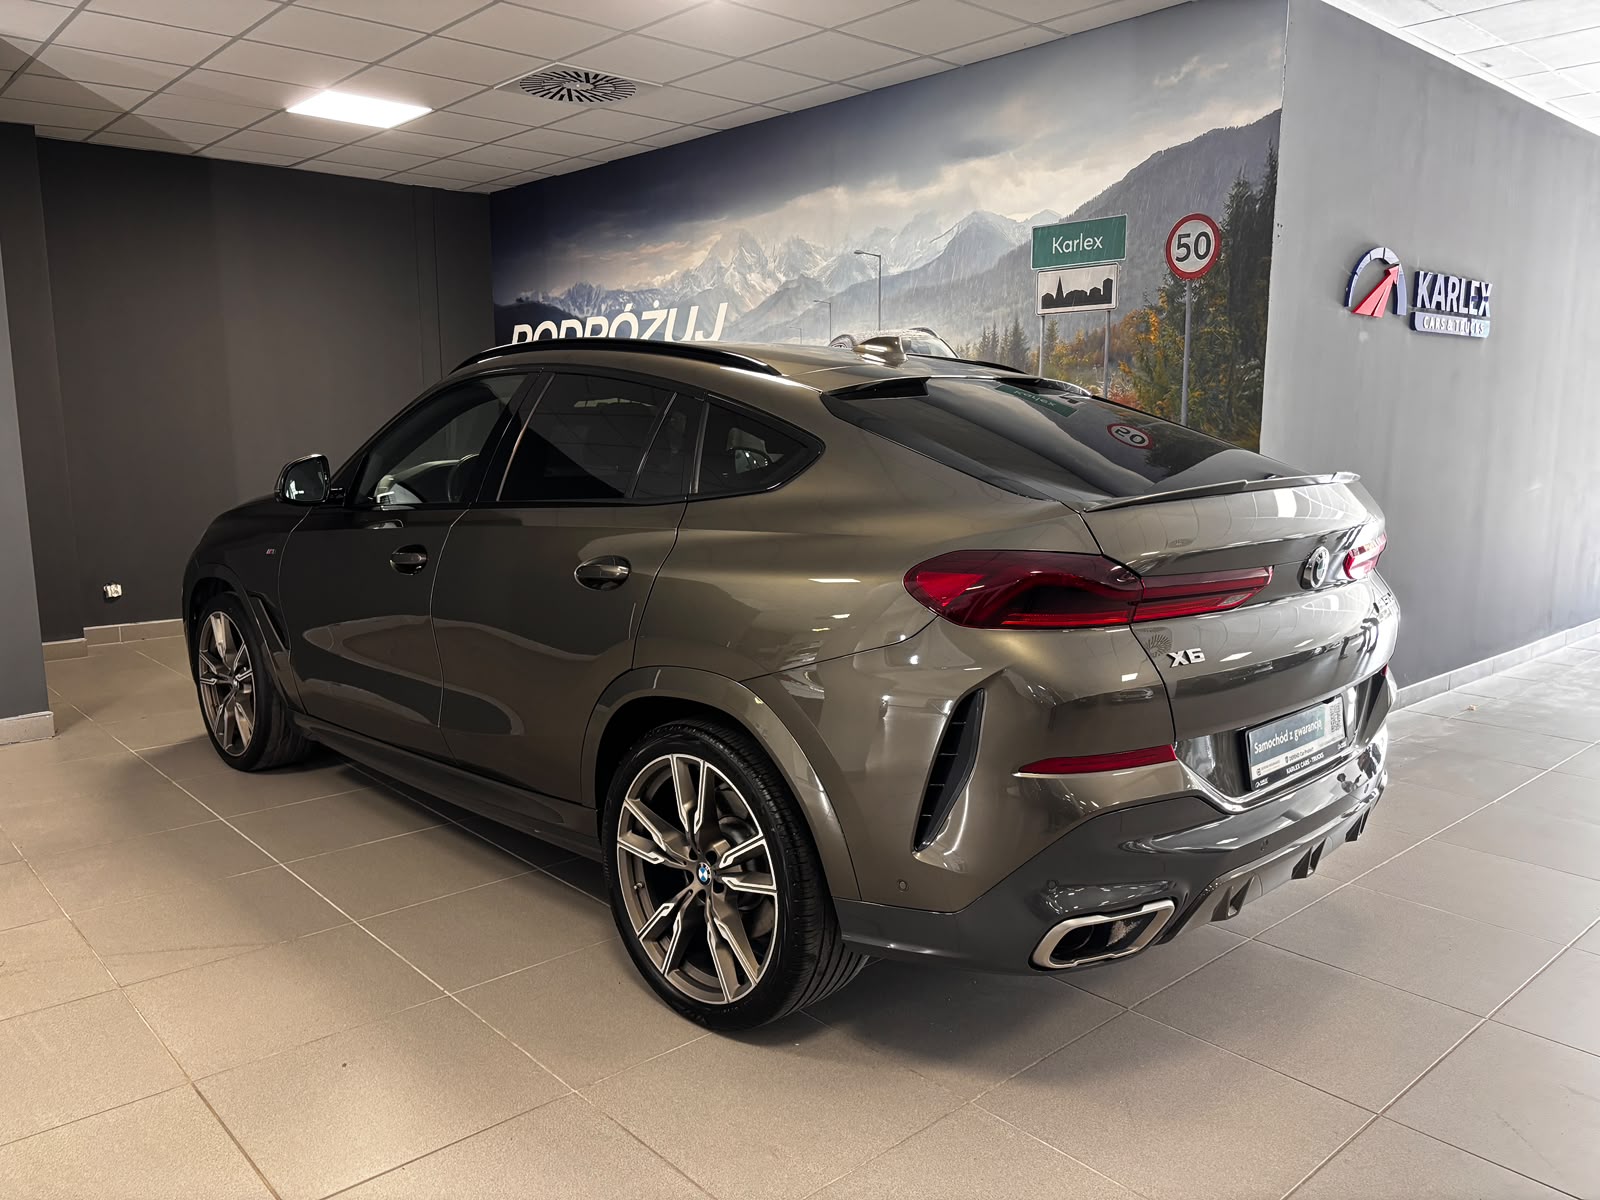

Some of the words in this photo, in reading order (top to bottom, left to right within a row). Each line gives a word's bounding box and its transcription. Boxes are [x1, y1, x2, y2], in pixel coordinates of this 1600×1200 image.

[1052, 233, 1103, 254] Karlex
[1175, 231, 1212, 263] 50
[1414, 270, 1493, 317] KARLEX
[1423, 316, 1446, 330] CARS
[1454, 318, 1485, 334] TRUCKS
[1166, 647, 1206, 668] X6
[1254, 729, 1288, 754] Samochód
